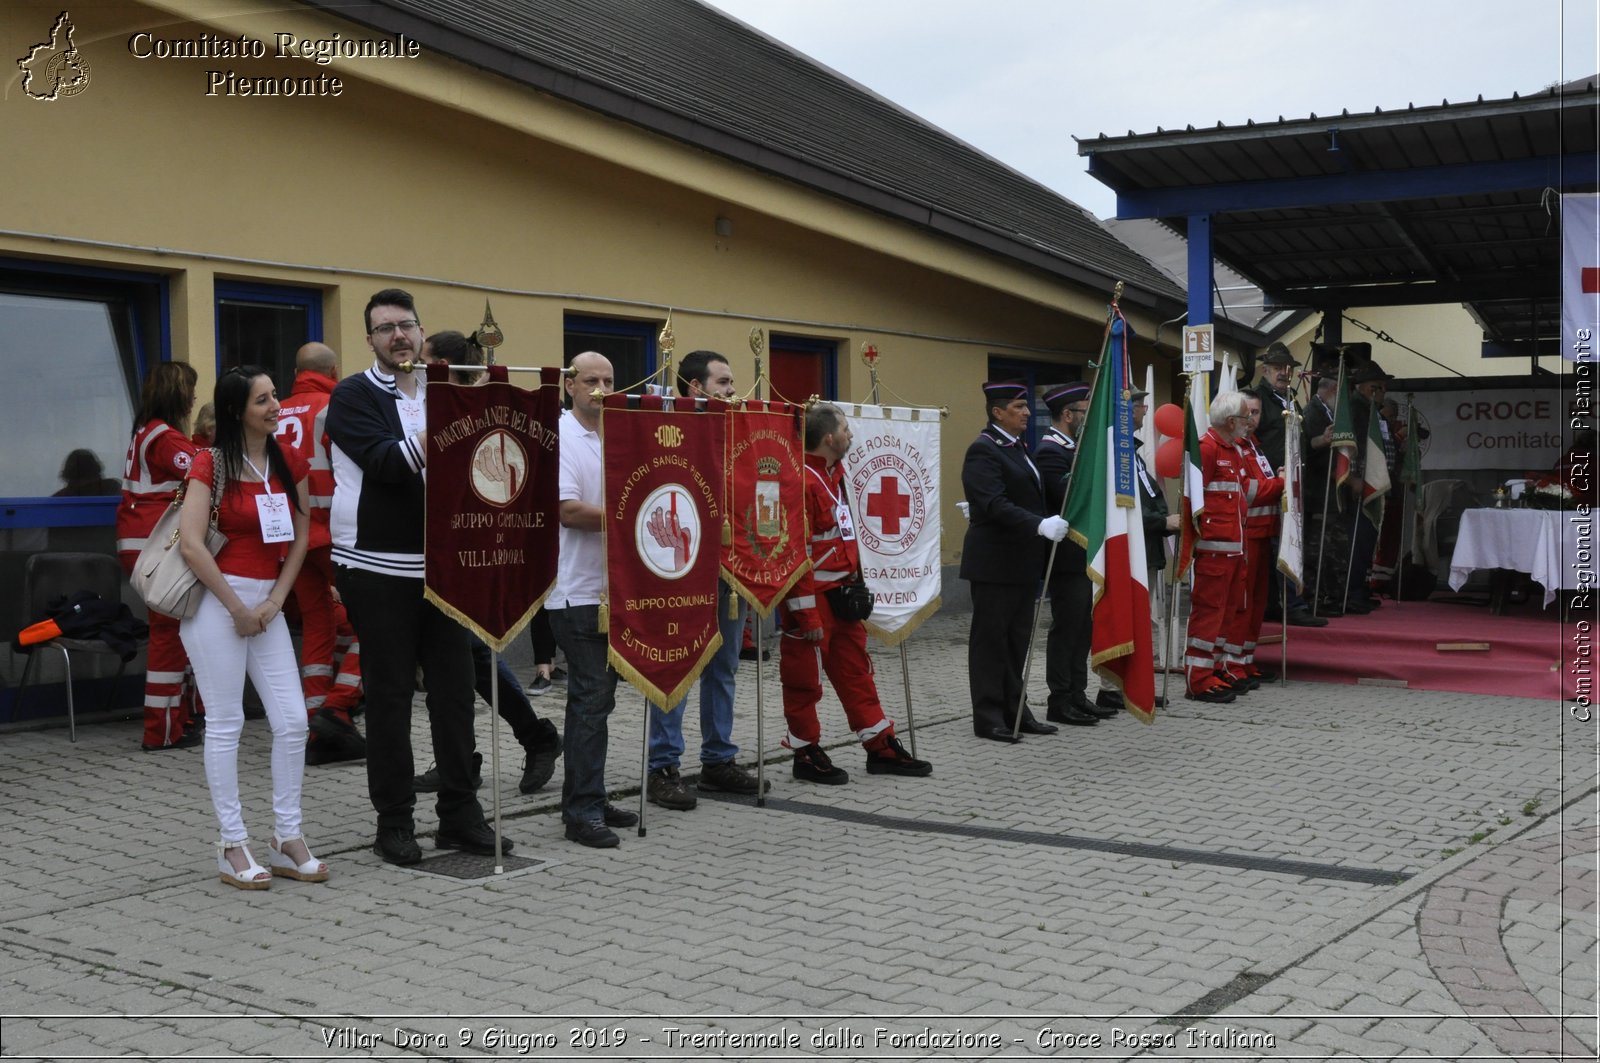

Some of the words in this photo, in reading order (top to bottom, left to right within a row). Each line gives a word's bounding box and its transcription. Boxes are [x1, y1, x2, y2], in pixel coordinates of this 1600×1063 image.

[1456, 401, 1550, 420] CROCE
[434, 415, 475, 452] DONATORI
[1467, 431, 1563, 450] Comitato
[865, 435, 901, 453] ROSSA
[904, 442, 935, 494] ITALIANA
[1120, 453, 1130, 490] SEZIONE
[616, 463, 650, 520] DONATORI
[653, 454, 688, 469] SANGUE
[690, 465, 719, 518] PIEMONTE
[861, 468, 871, 479] DI
[870, 456, 905, 472] GINEVRA
[905, 470, 917, 483] 22
[913, 486, 924, 530] AGOSTO
[459, 549, 525, 567] VILLARDORA
[864, 567, 922, 579] EGAZIONE
[923, 565, 933, 576] DI
[626, 598, 665, 611] GRUPPO
[668, 594, 715, 608] COMUNALE
[875, 591, 918, 604] AVENO
[668, 622, 679, 636] DI
[621, 627, 689, 662] BUTTIGLIERA
